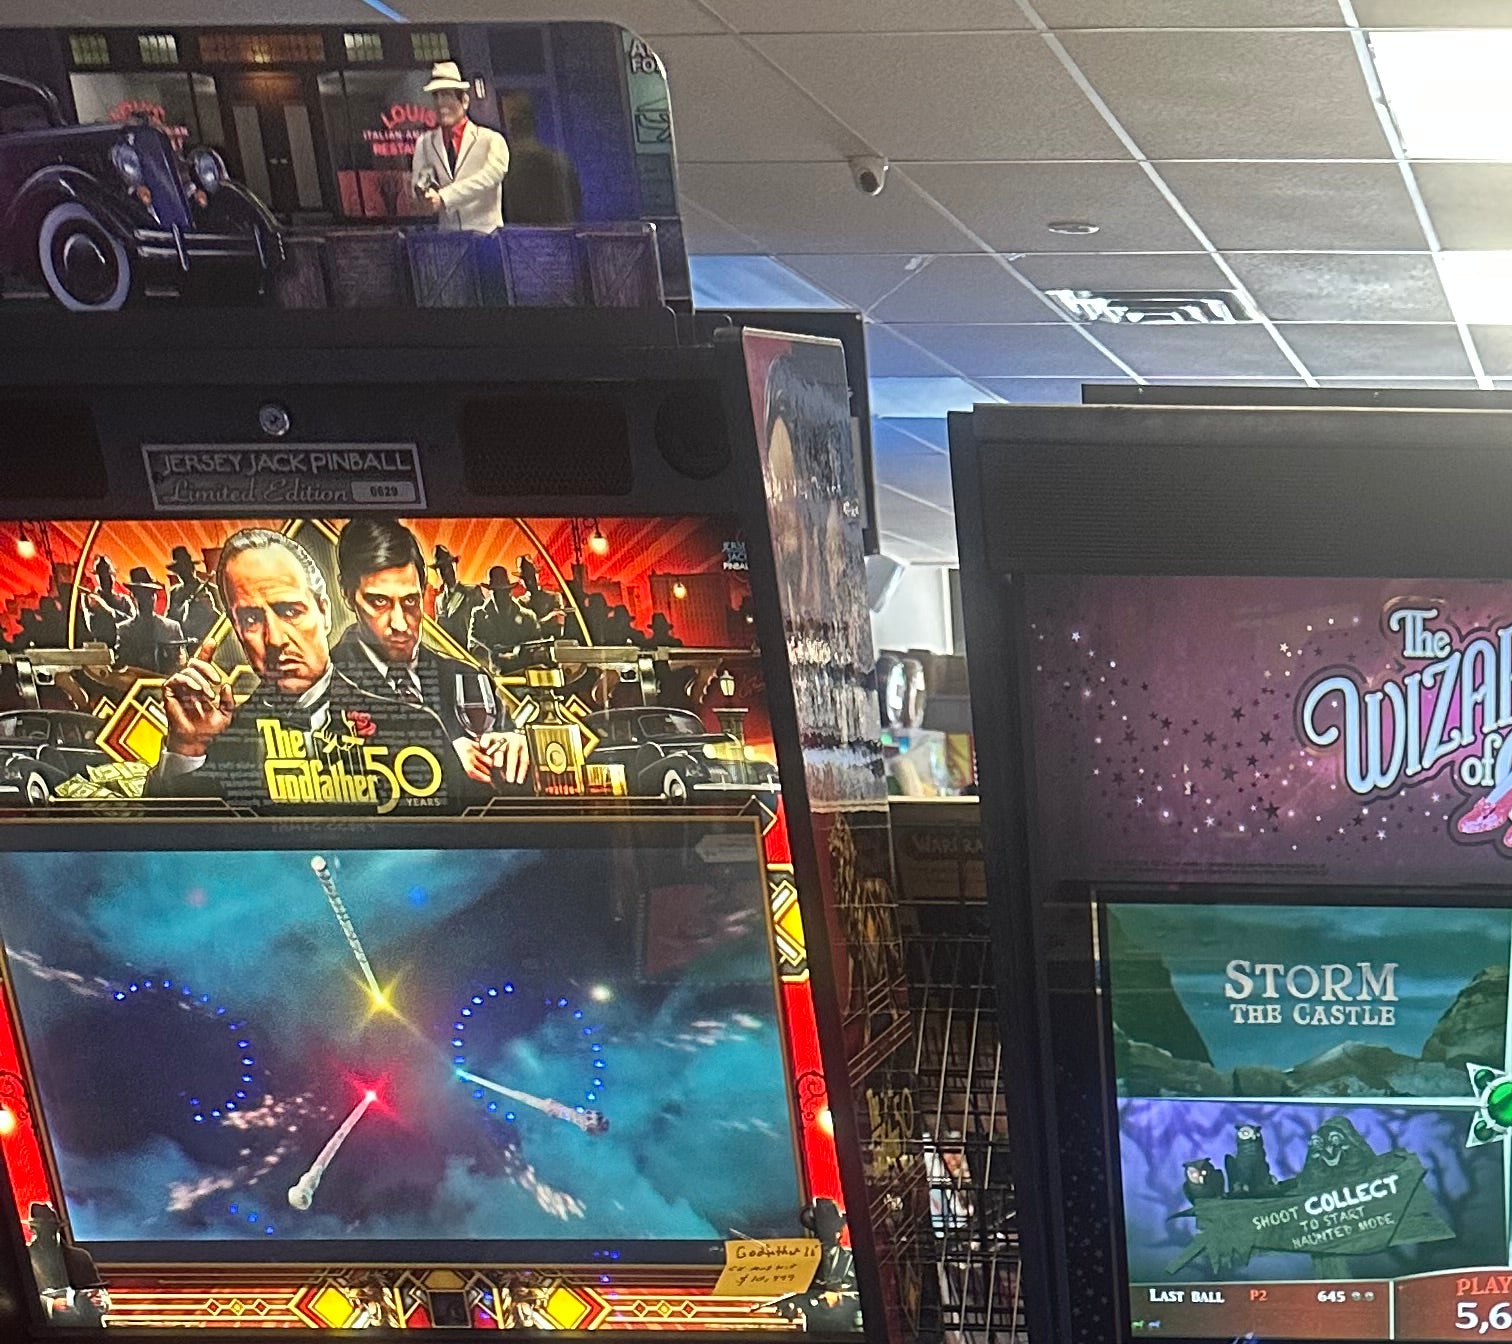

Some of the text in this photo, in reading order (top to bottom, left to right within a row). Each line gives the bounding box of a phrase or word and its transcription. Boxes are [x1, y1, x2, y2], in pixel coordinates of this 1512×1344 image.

[163, 452, 413, 476] JERSEY JACK PINBALL
[163, 478, 348, 502] Limited Edition
[1390, 609, 1451, 659] The
[256, 718, 307, 760] The
[1461, 733, 1502, 786] of
[264, 745, 442, 815] Godfather 50
[405, 797, 442, 807] YEARS
[1224, 959, 1400, 1002] STORM
[1230, 1003, 1397, 1027] THE CASTLE
[1252, 1174, 1399, 1231] SHOOT COLLECT
[1300, 1205, 1366, 1232] TO START
[1149, 1288, 1346, 1303] LAST BALL P2 645
